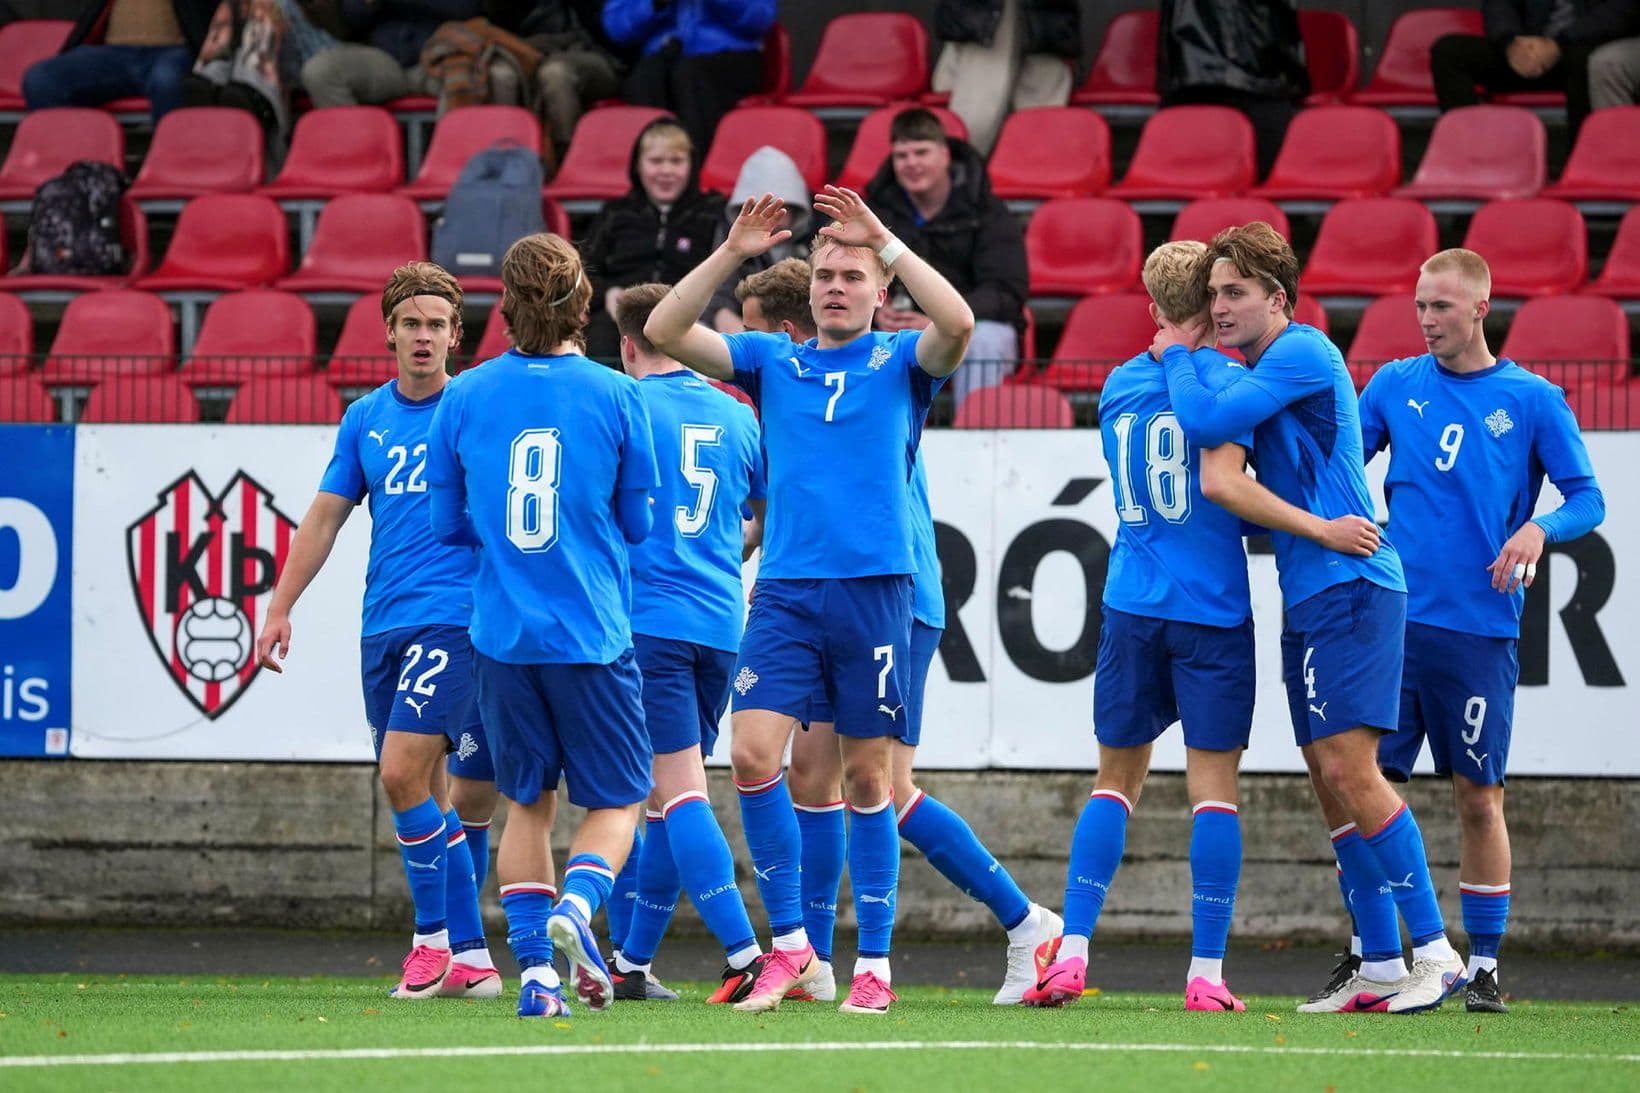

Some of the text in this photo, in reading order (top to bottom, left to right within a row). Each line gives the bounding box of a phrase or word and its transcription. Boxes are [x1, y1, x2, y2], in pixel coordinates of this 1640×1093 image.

[824, 371, 847, 423] 7
[384, 443, 427, 495] 22
[1112, 411, 1192, 526] 18
[1434, 423, 1465, 472] 9
[506, 427, 562, 554] 8
[675, 423, 724, 538] 5
[397, 643, 449, 697] 22
[873, 644, 894, 699] 7
[1303, 647, 1316, 699] 4
[1461, 695, 1488, 746] 9
